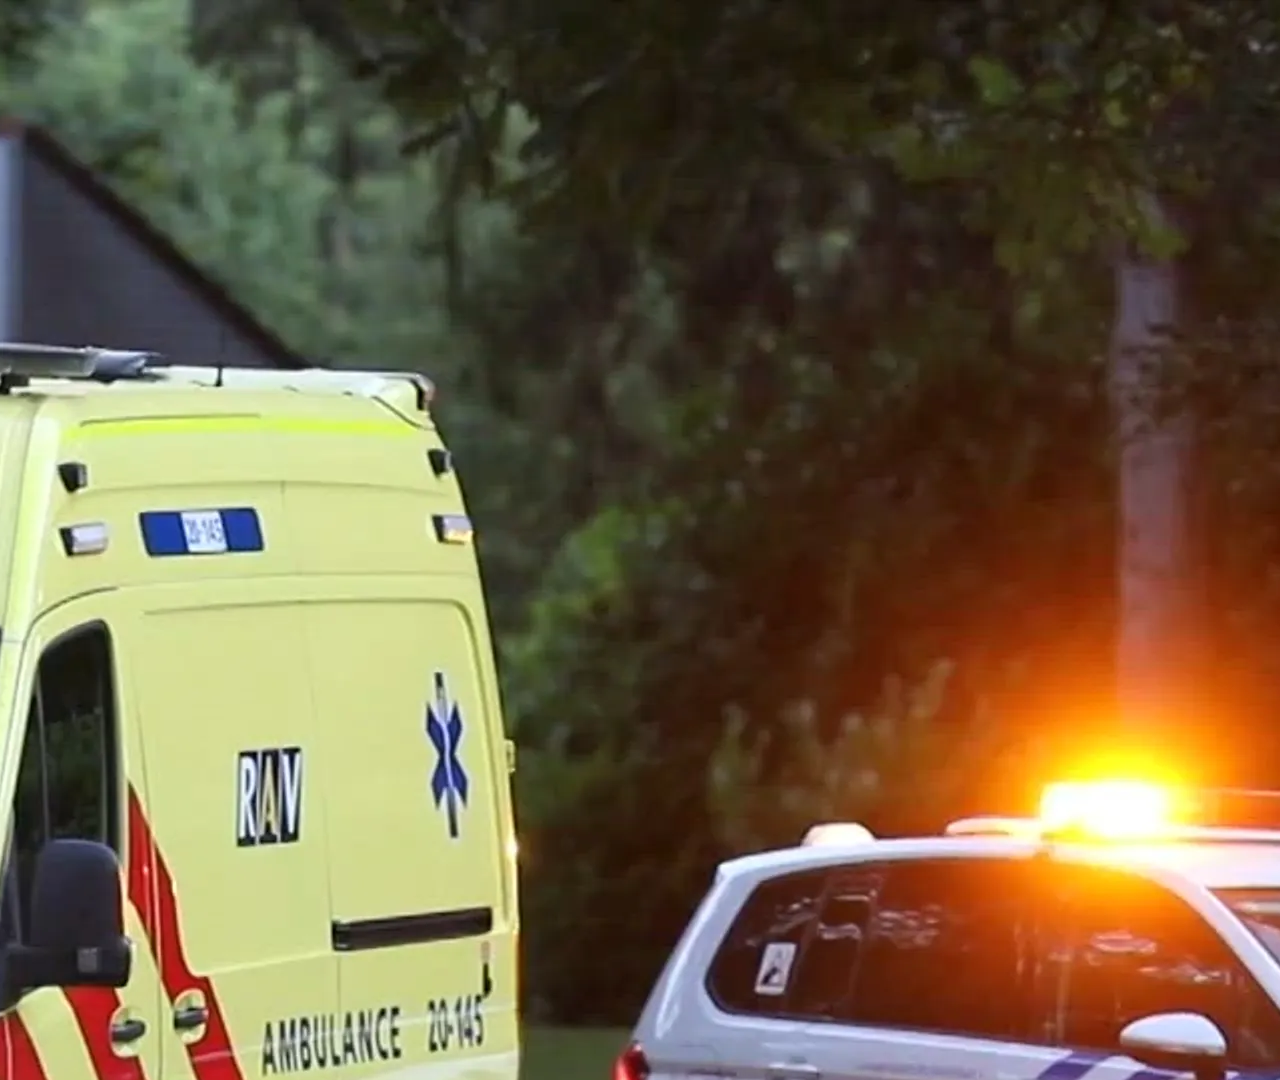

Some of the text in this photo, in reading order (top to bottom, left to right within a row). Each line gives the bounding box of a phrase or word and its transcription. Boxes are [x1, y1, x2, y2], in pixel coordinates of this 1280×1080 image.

[238, 751, 302, 839] RAV
[261, 993, 485, 1076] AMBULANCE 20-145
